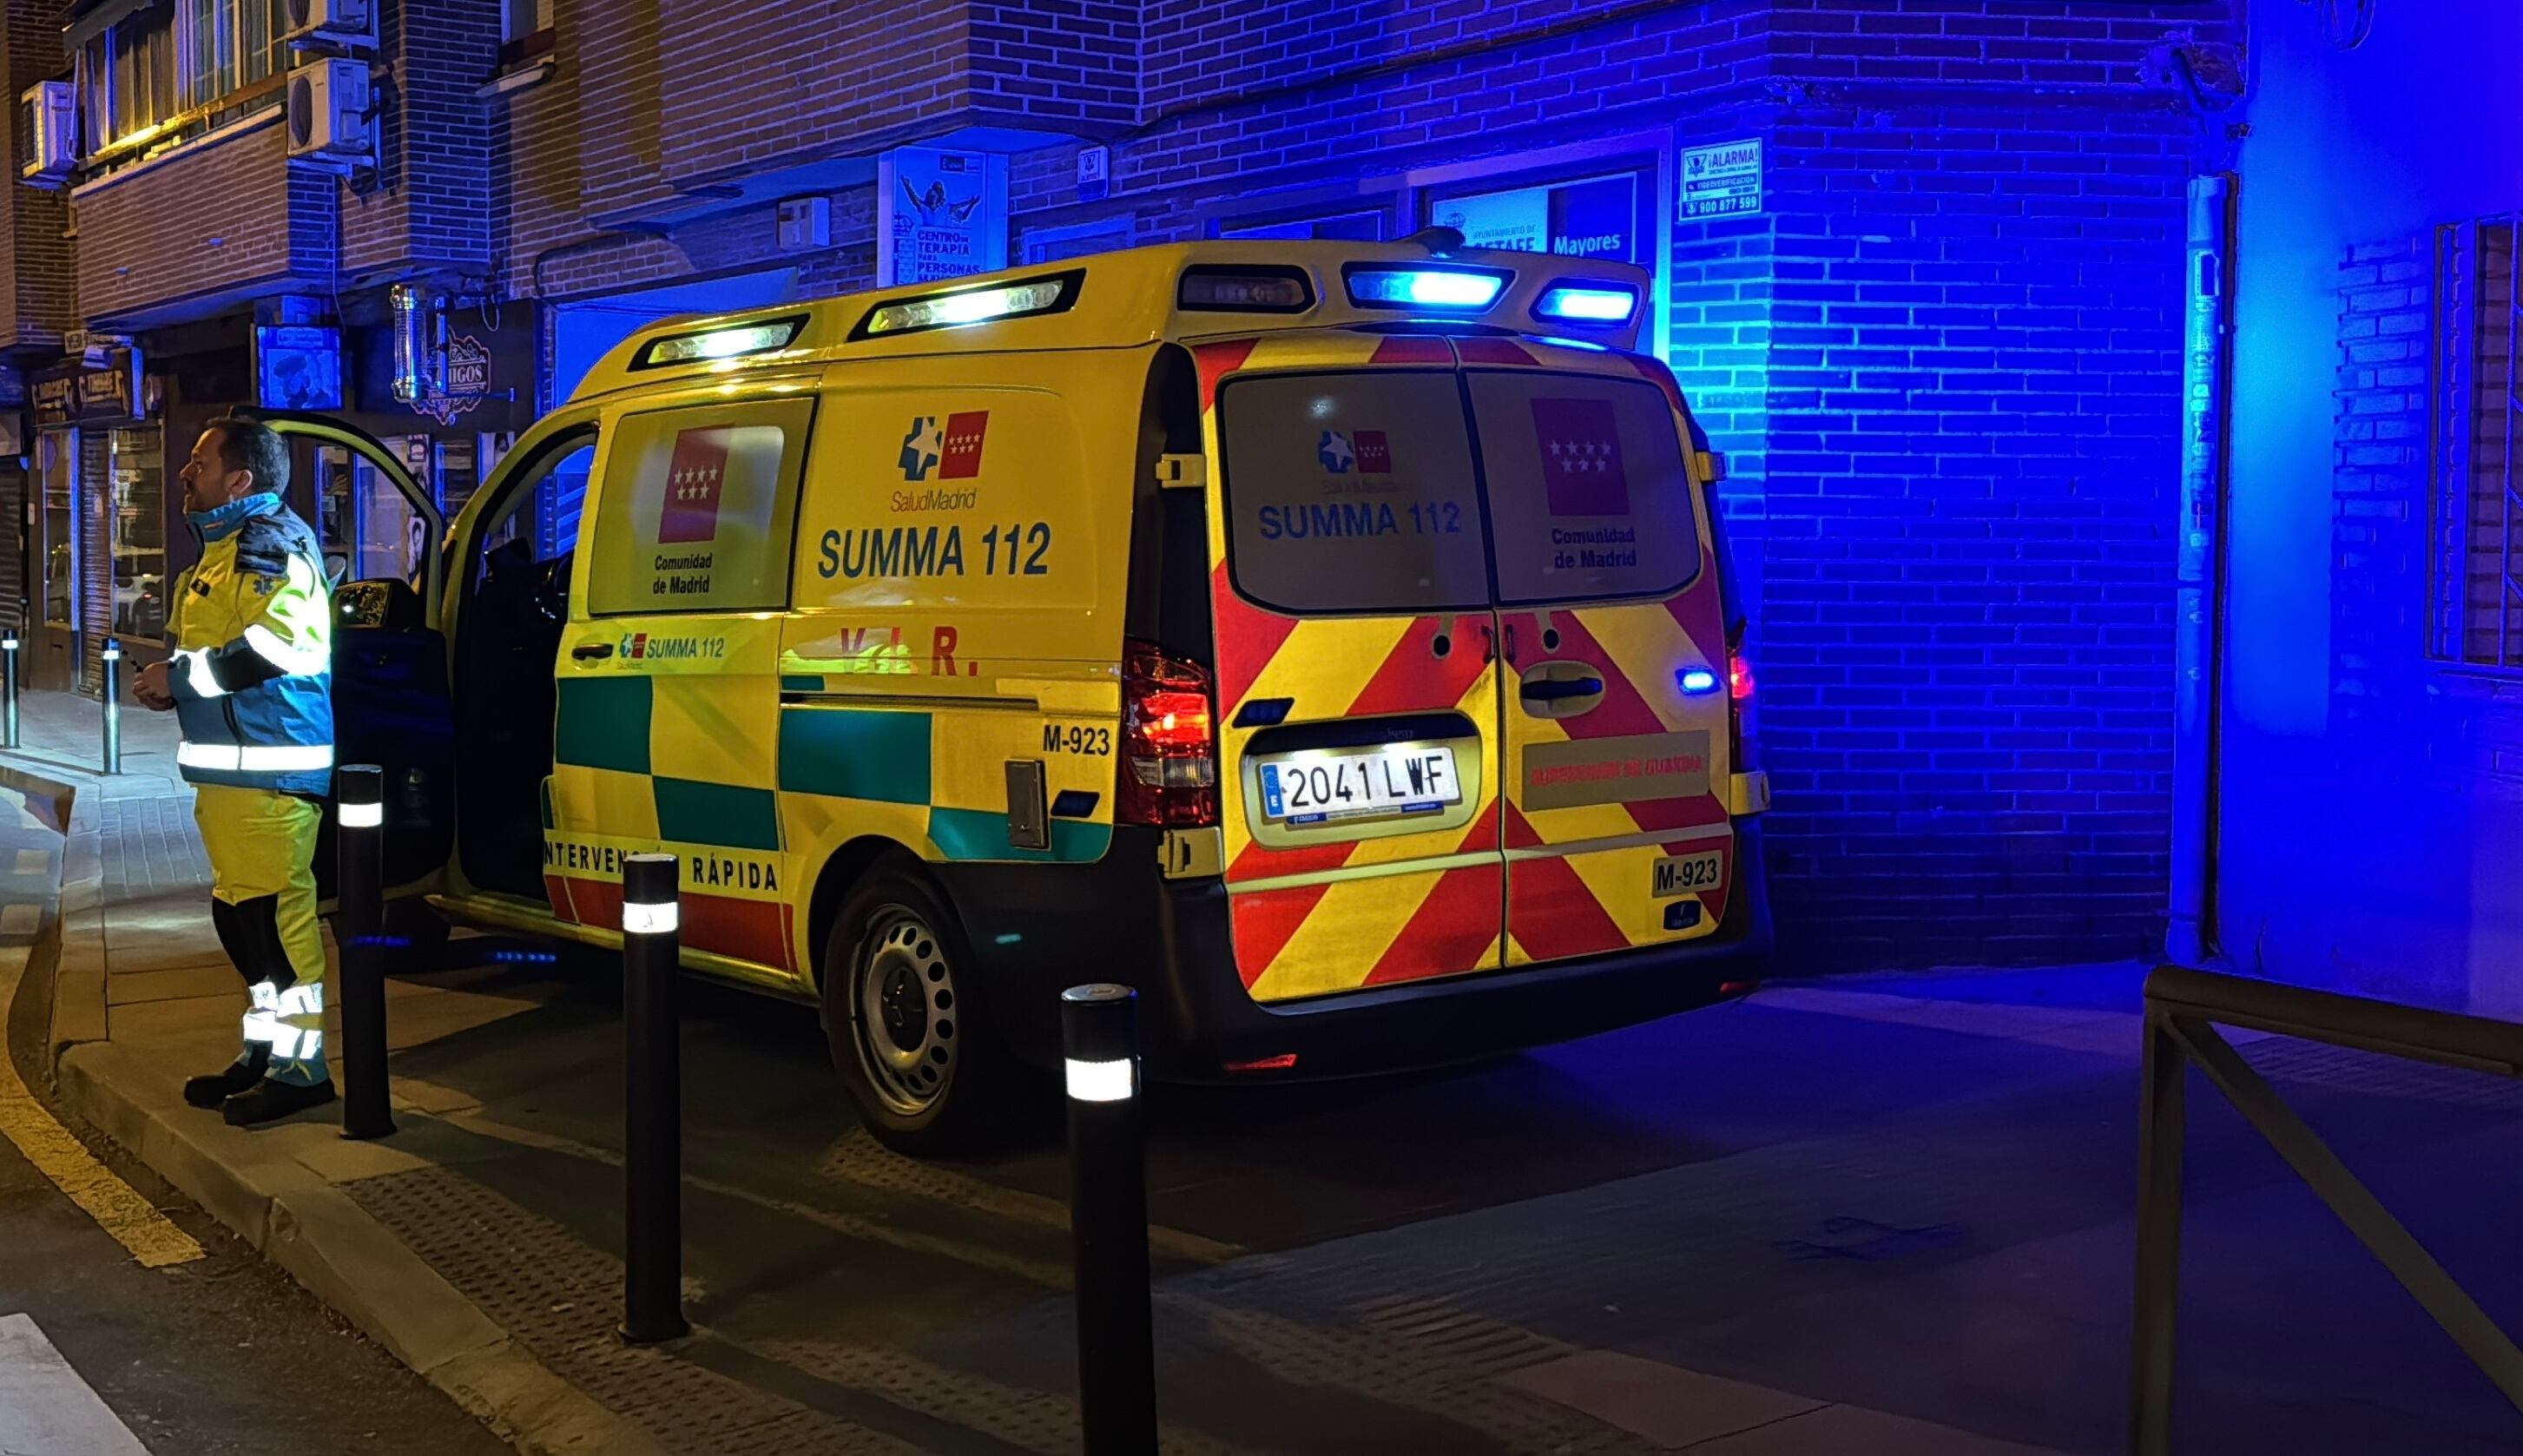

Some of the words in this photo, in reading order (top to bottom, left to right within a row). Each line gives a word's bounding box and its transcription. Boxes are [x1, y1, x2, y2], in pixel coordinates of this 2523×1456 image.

[1709, 148, 1758, 168] ¡ALARMA!
[1699, 201, 1716, 214] 900
[1719, 198, 1736, 212] 877
[1739, 196, 1757, 209] 599
[917, 230, 960, 243] CENTRO
[1553, 234, 1621, 257] Mayores
[918, 242, 970, 255] TERAPIA
[918, 261, 980, 275] PERSONAS
[891, 488, 977, 512] SaludMadrid
[1258, 502, 1399, 540] SUMMA
[1408, 500, 1461, 535] 112
[1551, 527, 1636, 545] Comunidad
[817, 525, 965, 578] SUMMA
[981, 521, 1051, 576] 112
[1554, 550, 1575, 569] de
[1580, 549, 1637, 568] Madrid
[655, 551, 713, 570] Comunidad
[653, 576, 667, 595] de
[669, 574, 710, 595] Madrid
[647, 638, 697, 659] SUMMA
[702, 636, 725, 658] 112
[1043, 724, 1110, 756] M-923
[1288, 762, 1372, 807] 2041
[1382, 755, 1444, 799] LWF
[1270, 795, 1279, 807] E
[692, 852, 779, 892] RÁPIDA
[1657, 858, 1718, 891] M-923
